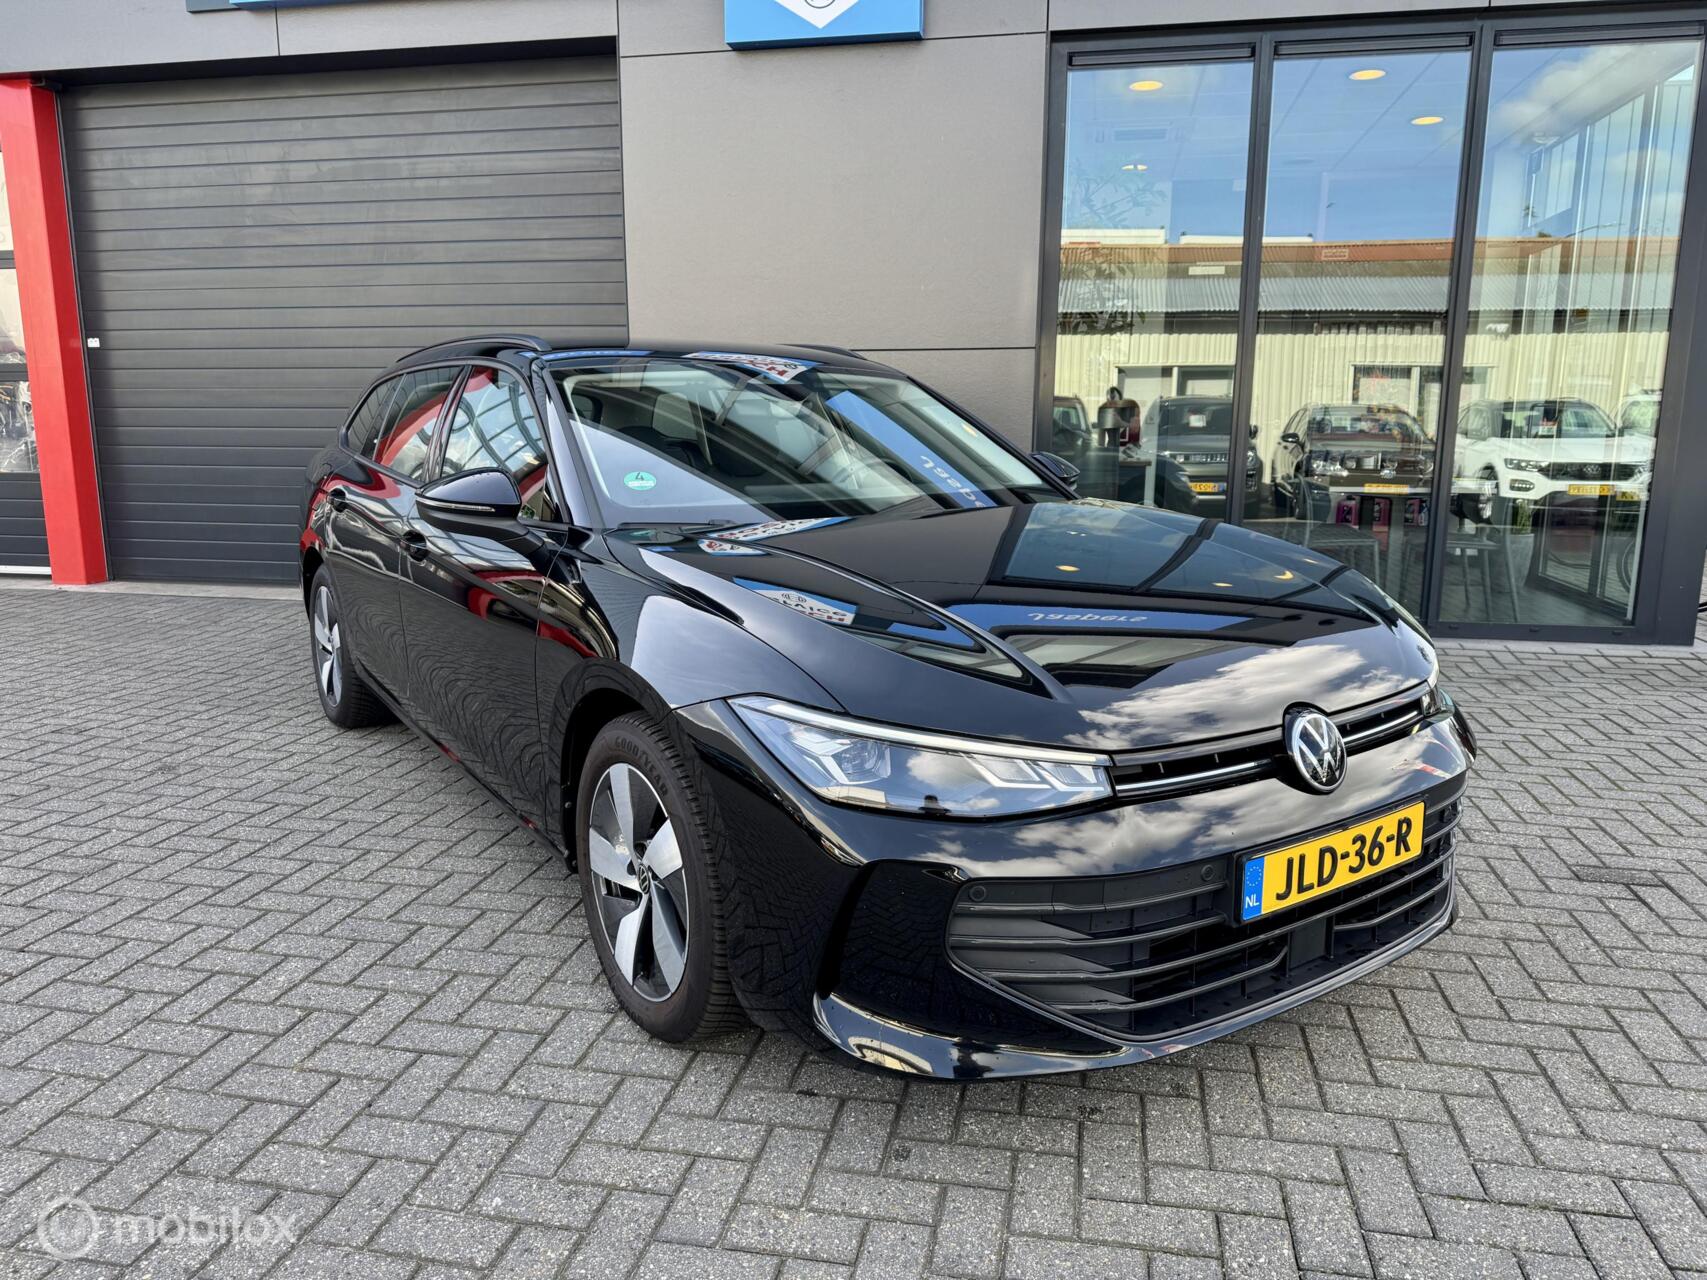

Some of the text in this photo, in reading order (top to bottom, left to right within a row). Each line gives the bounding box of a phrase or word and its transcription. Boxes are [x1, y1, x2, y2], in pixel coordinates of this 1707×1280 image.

[614, 736, 668, 796] GOODYEAR
[1275, 816, 1412, 901] JLD-36-R
[1245, 893, 1260, 909] NL
